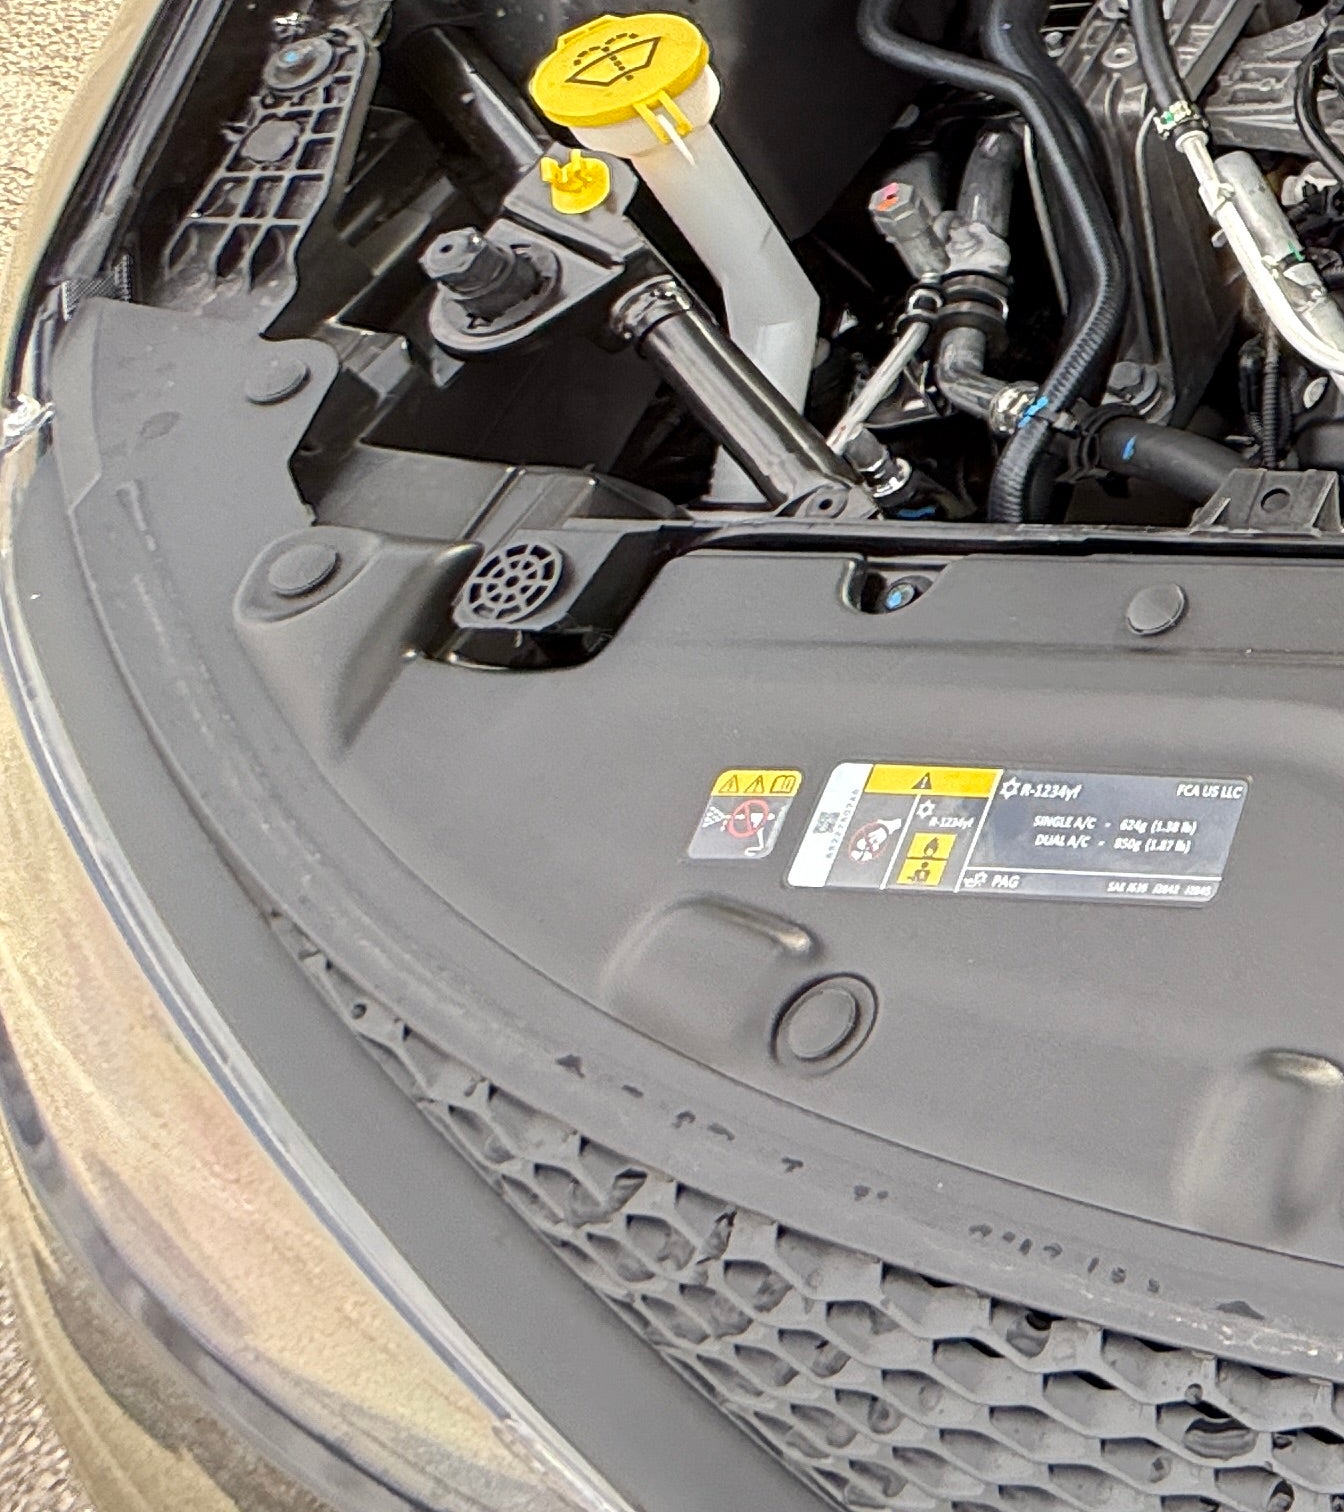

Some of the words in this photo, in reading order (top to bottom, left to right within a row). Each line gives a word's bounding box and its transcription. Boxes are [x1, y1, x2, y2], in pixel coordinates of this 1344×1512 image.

[1020, 783, 1083, 801] R-1234yf
[1176, 784, 1200, 798] FCA
[1202, 785, 1219, 798] US
[1220, 786, 1243, 799] LLC
[1073, 816, 1097, 830] A/C
[1034, 833, 1066, 846] DUAL
[1067, 834, 1091, 848] A/C
[991, 873, 1020, 888] PAG
